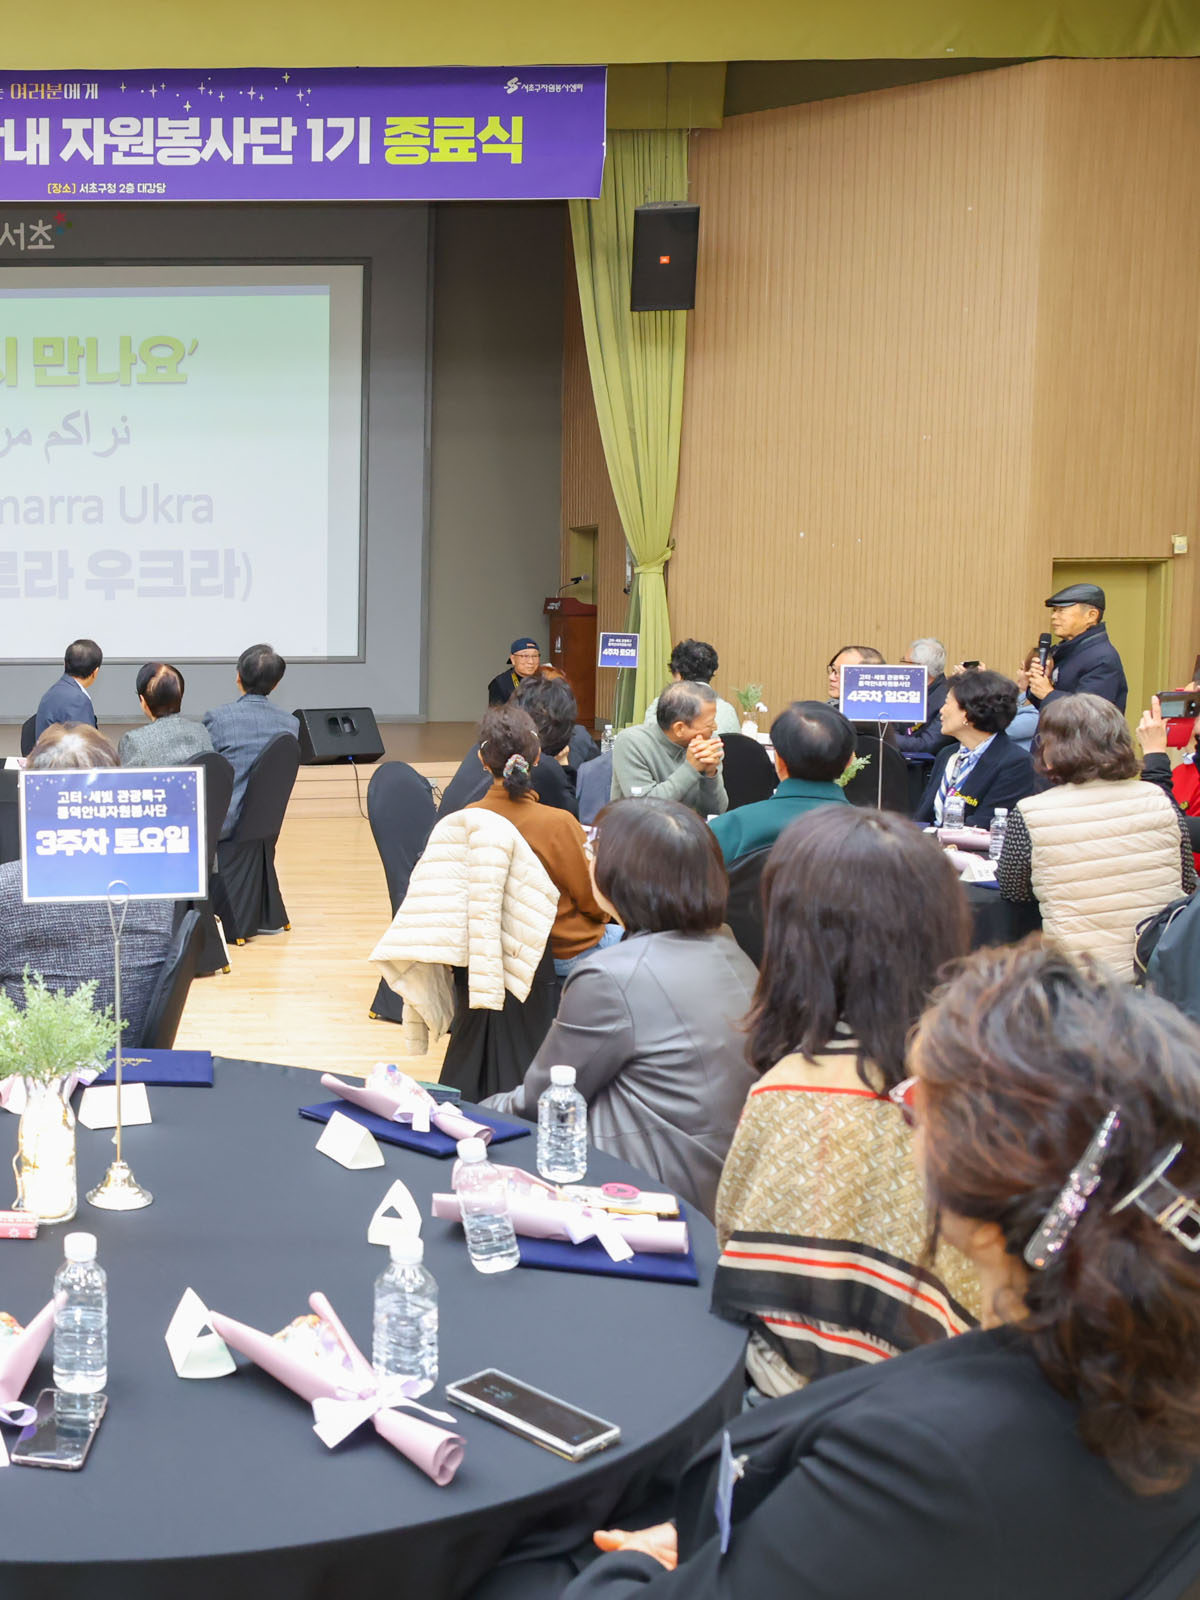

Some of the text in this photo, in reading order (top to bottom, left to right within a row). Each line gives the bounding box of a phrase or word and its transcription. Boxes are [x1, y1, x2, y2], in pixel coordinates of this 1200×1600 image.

[10, 82, 98, 100] 여러분에게
[59, 117, 298, 165] 자원봉사단
[305, 117, 370, 164] 1기
[383, 116, 523, 165] 종료식
[47, 182, 166, 194] [장소] 서초구청 2층 대강당
[44, 410, 131, 464] نراكم
[119, 483, 215, 525] Ukra
[85, 548, 253, 602] 우크라)
[847, 690, 921, 704] 4주차 일요일
[117, 789, 166, 803] 관광특구
[57, 803, 167, 819] 통역안내자원봉사단
[36, 825, 190, 856] 3주차 토요일
